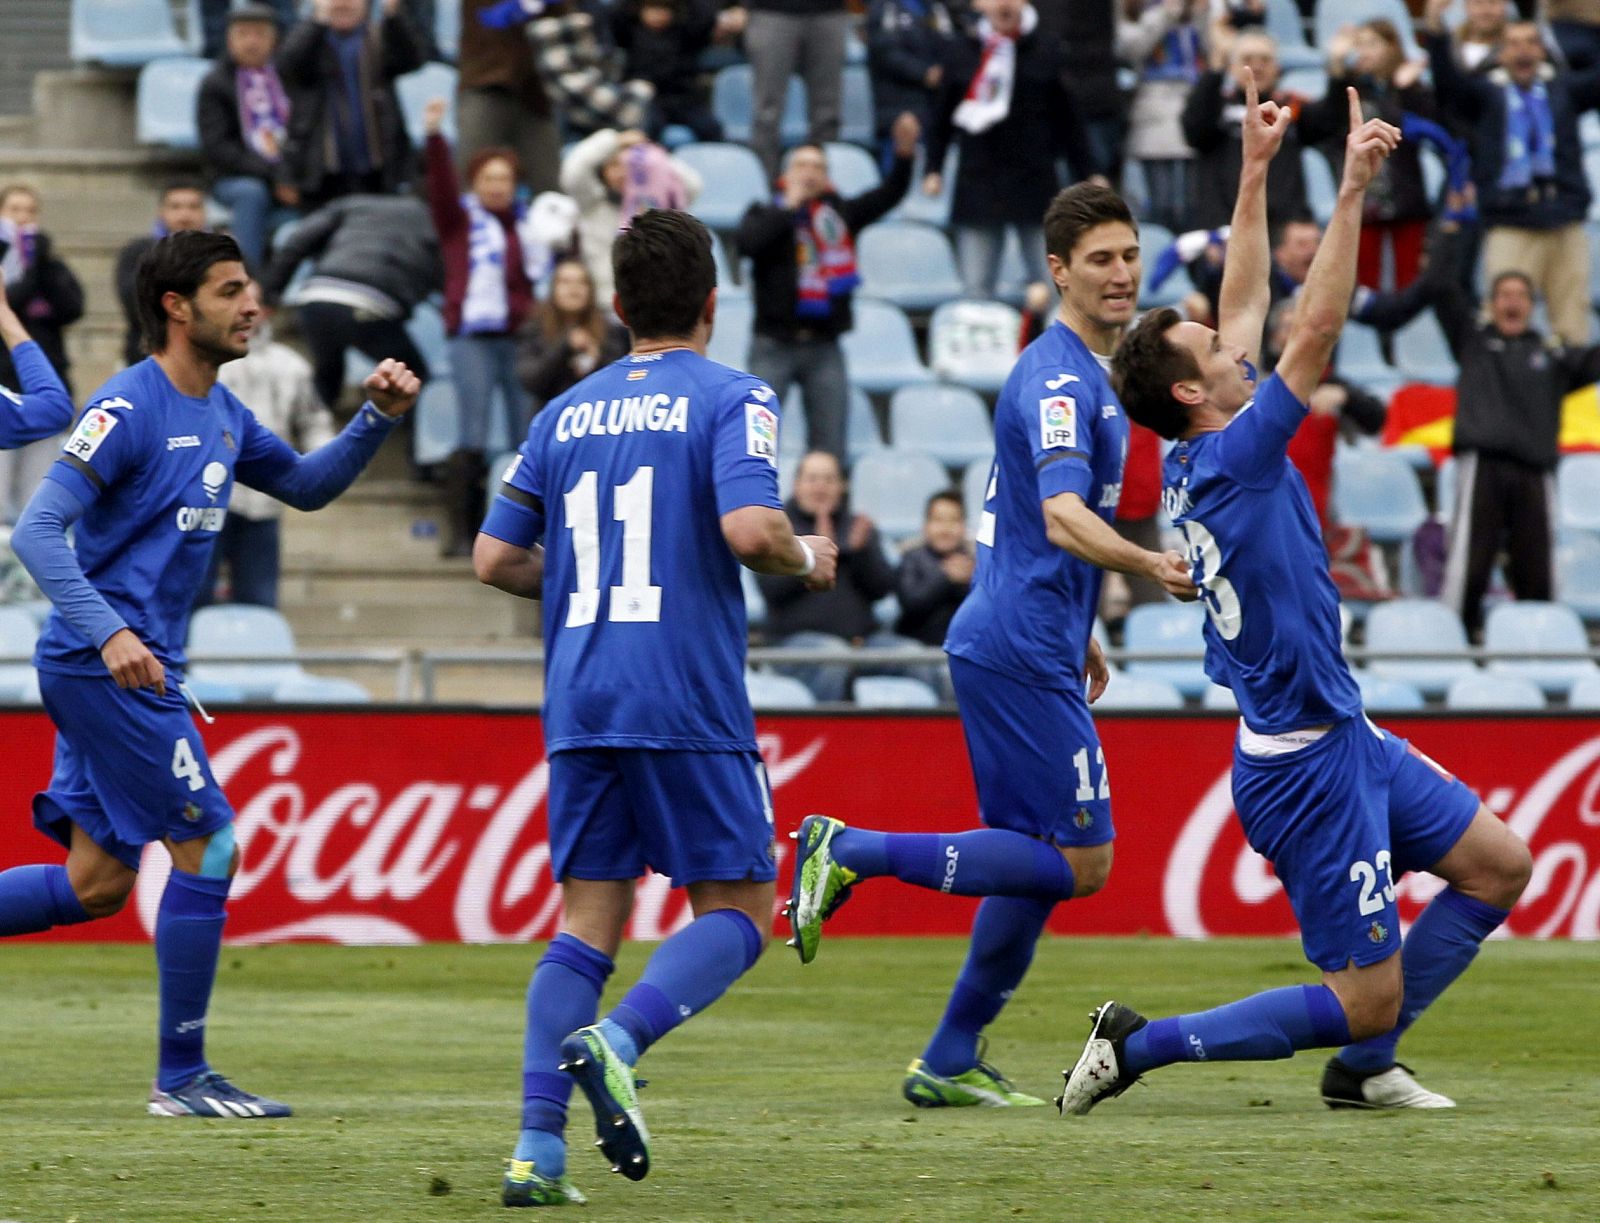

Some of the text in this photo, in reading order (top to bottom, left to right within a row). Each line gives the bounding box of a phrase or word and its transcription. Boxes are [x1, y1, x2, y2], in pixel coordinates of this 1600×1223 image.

[555, 394, 689, 443] COLUNGA
[1046, 429, 1071, 445] LFP
[563, 466, 663, 628] 11
[171, 737, 206, 792] 4
[1072, 745, 1110, 801] 12
[1349, 849, 1396, 916] 23
